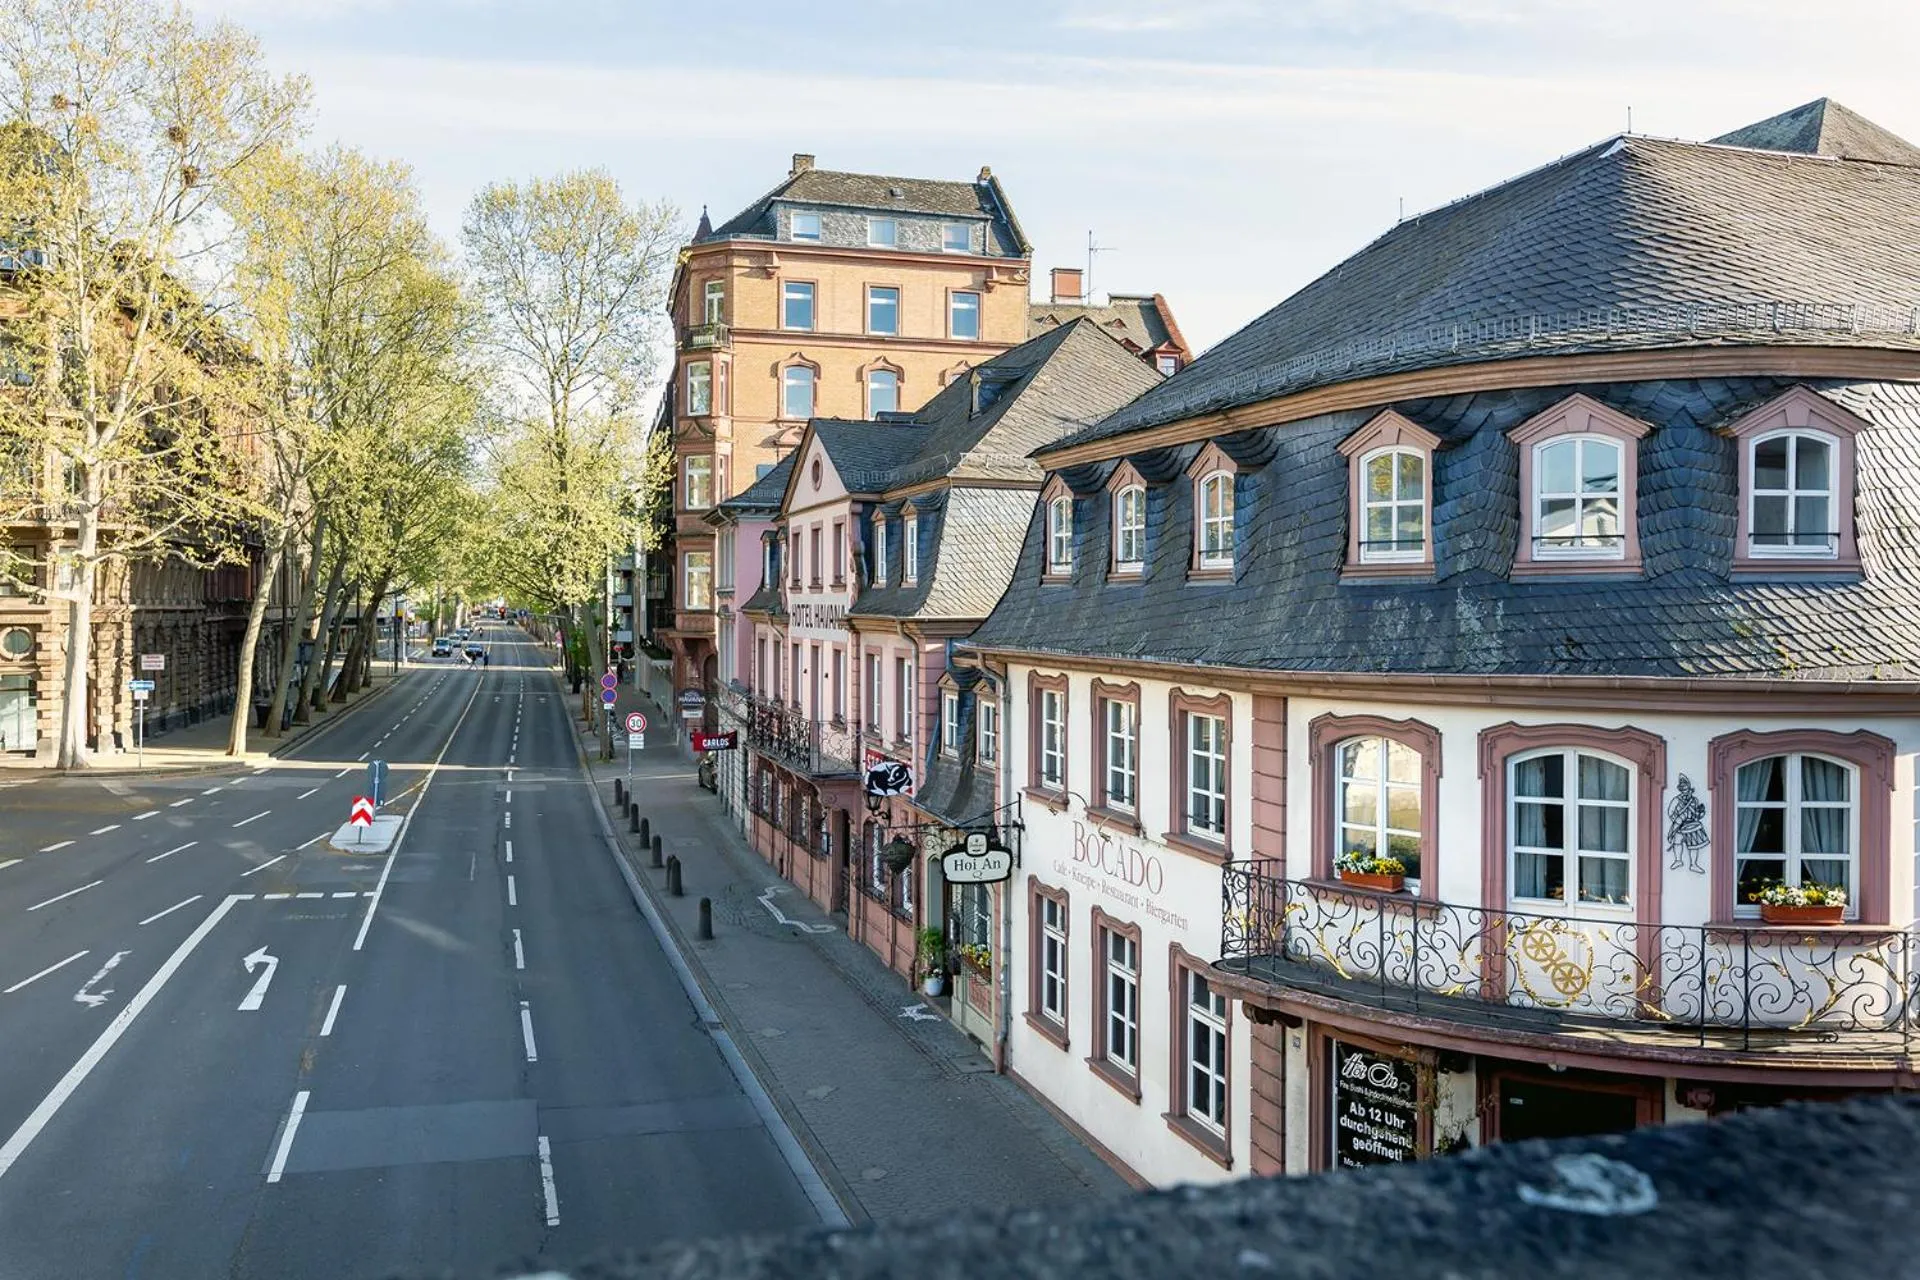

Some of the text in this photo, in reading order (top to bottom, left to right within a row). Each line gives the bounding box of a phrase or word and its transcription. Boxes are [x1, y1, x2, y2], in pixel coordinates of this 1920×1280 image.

[791, 604, 814, 628] HOTEL
[630, 718, 643, 728] 30
[702, 738, 730, 749] CARLOS
[954, 858, 1001, 872] Hoi An
[1072, 820, 1163, 895] BOCADO
[1101, 879, 1139, 910] Restaurant
[1145, 898, 1189, 931] Biergarten
[1349, 1101, 1406, 1129] Ab 12 Uhr
[1339, 1114, 1413, 1149] durchgehend
[1352, 1137, 1403, 1162] geöffnet!
